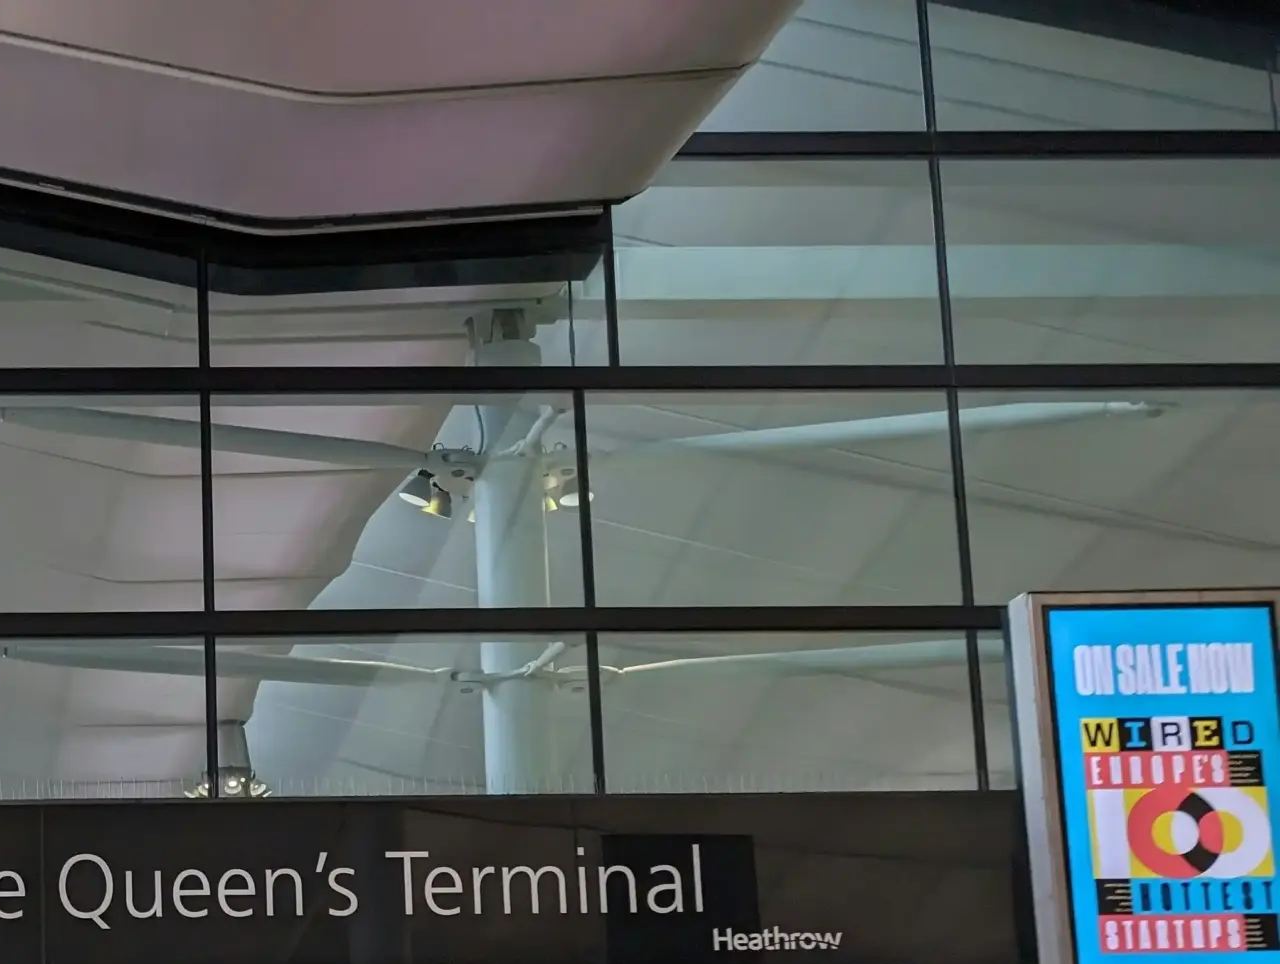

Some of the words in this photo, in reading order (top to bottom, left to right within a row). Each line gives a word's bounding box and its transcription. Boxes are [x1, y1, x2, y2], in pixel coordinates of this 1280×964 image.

[1074, 644, 1115, 696] ON
[1116, 643, 1187, 695] SALE
[1187, 642, 1254, 694] NOW
[1083, 720, 1254, 748] WIRED
[1090, 754, 1225, 785] EUROPE'S
[1093, 786, 1272, 880] 100
[58, 852, 360, 930] Queen's
[385, 843, 705, 917] Terminal
[1139, 881, 1273, 911] HOTTEST
[713, 925, 843, 951] Heathrow
[1105, 918, 1241, 950] STARTUPS
